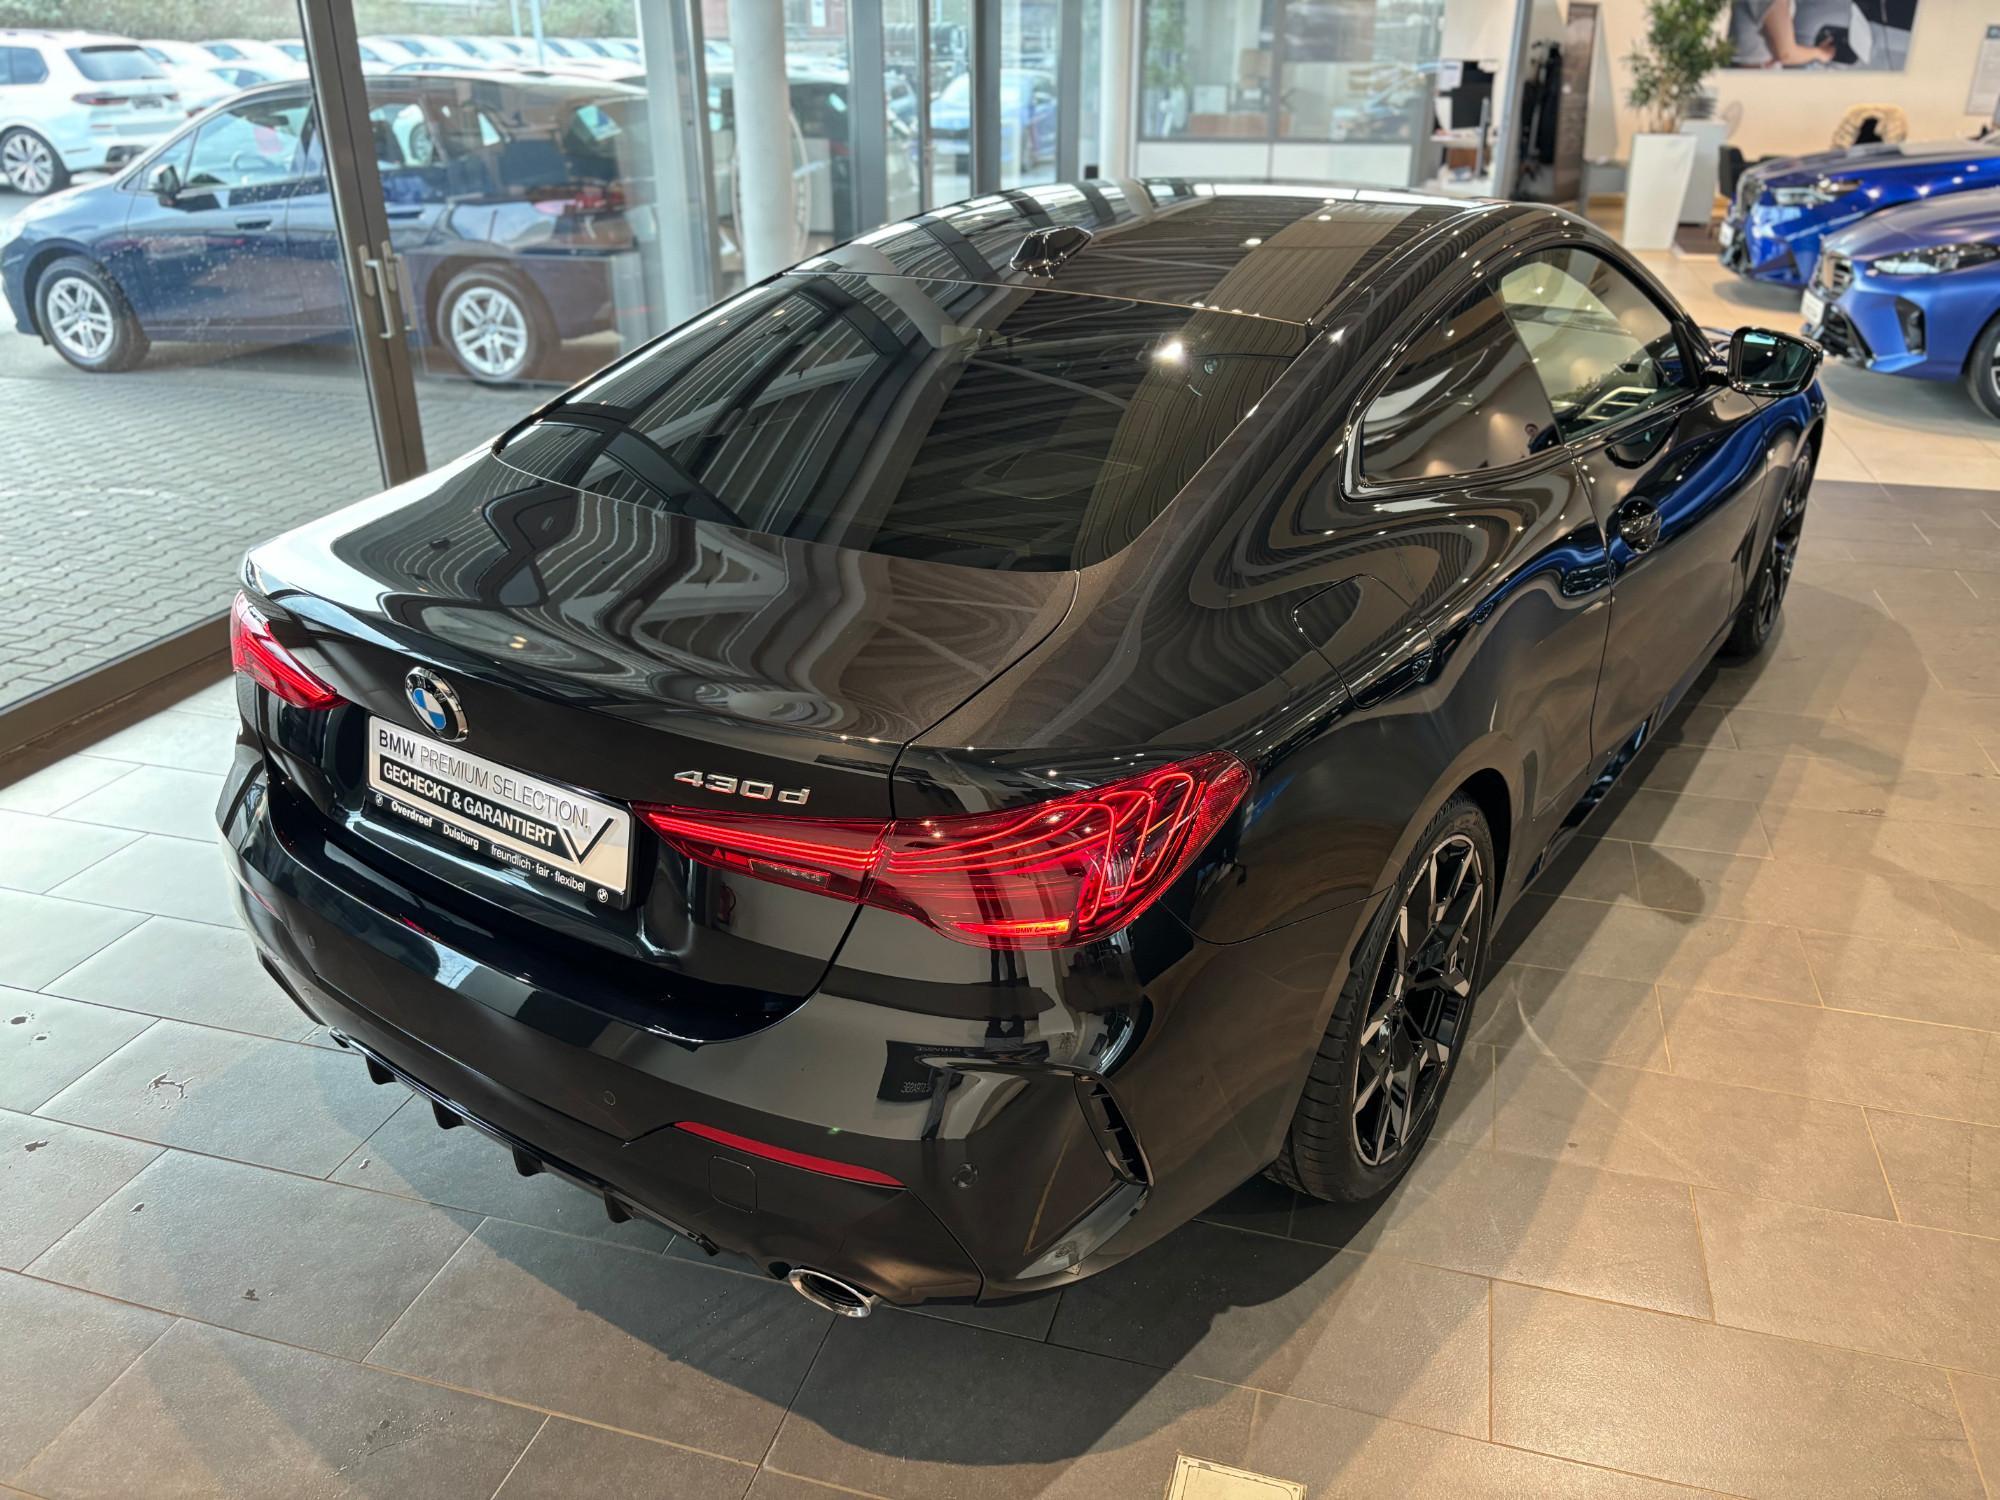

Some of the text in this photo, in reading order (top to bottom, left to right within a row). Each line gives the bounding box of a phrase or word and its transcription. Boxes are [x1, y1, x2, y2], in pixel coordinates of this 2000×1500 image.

[379, 729, 415, 759] BMW
[420, 745, 489, 790] PREMIUM
[384, 762, 556, 847] GECHECKT & GARANTIERT
[673, 769, 811, 806] 430d
[391, 802, 433, 828] Overdreef
[443, 824, 479, 850] Duisburg
[491, 845, 586, 893] freundlich fair flexibel
